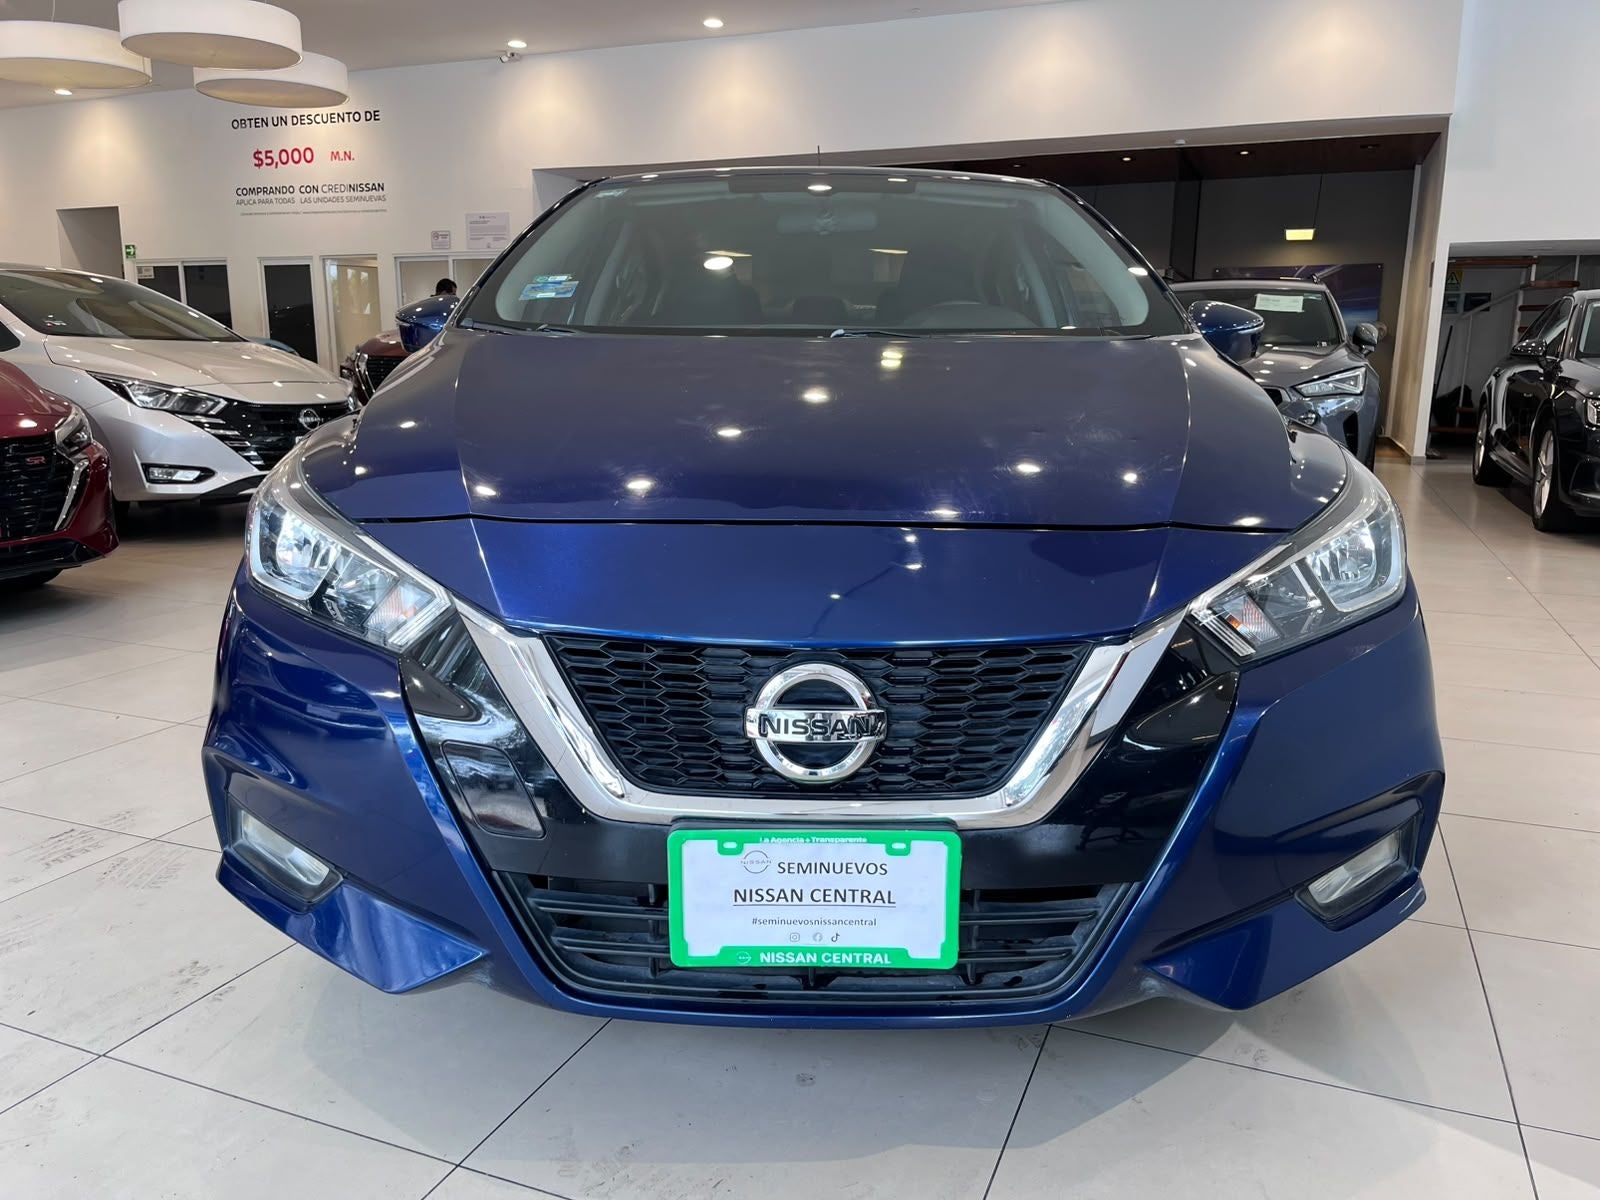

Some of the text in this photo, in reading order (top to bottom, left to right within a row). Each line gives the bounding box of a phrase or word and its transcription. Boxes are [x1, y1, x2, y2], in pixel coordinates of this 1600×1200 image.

[231, 110, 381, 130] OBTEN UN DESCUENTO DE
[252, 147, 355, 169] $5,000 M.N.
[235, 182, 385, 197] COMPRANDO CON CREDINISSAN
[235, 194, 387, 206] APLICA PARA TODAS LAS UNIDADES SEMINUEVAS
[758, 713, 870, 737] NISSAN
[777, 861, 888, 876] SEMINUEVOS
[733, 888, 897, 905] NISSAN CENTRAL
[752, 916, 877, 927] #seminuevosnissancentral
[759, 951, 892, 965] NISSAN CENTRAL
